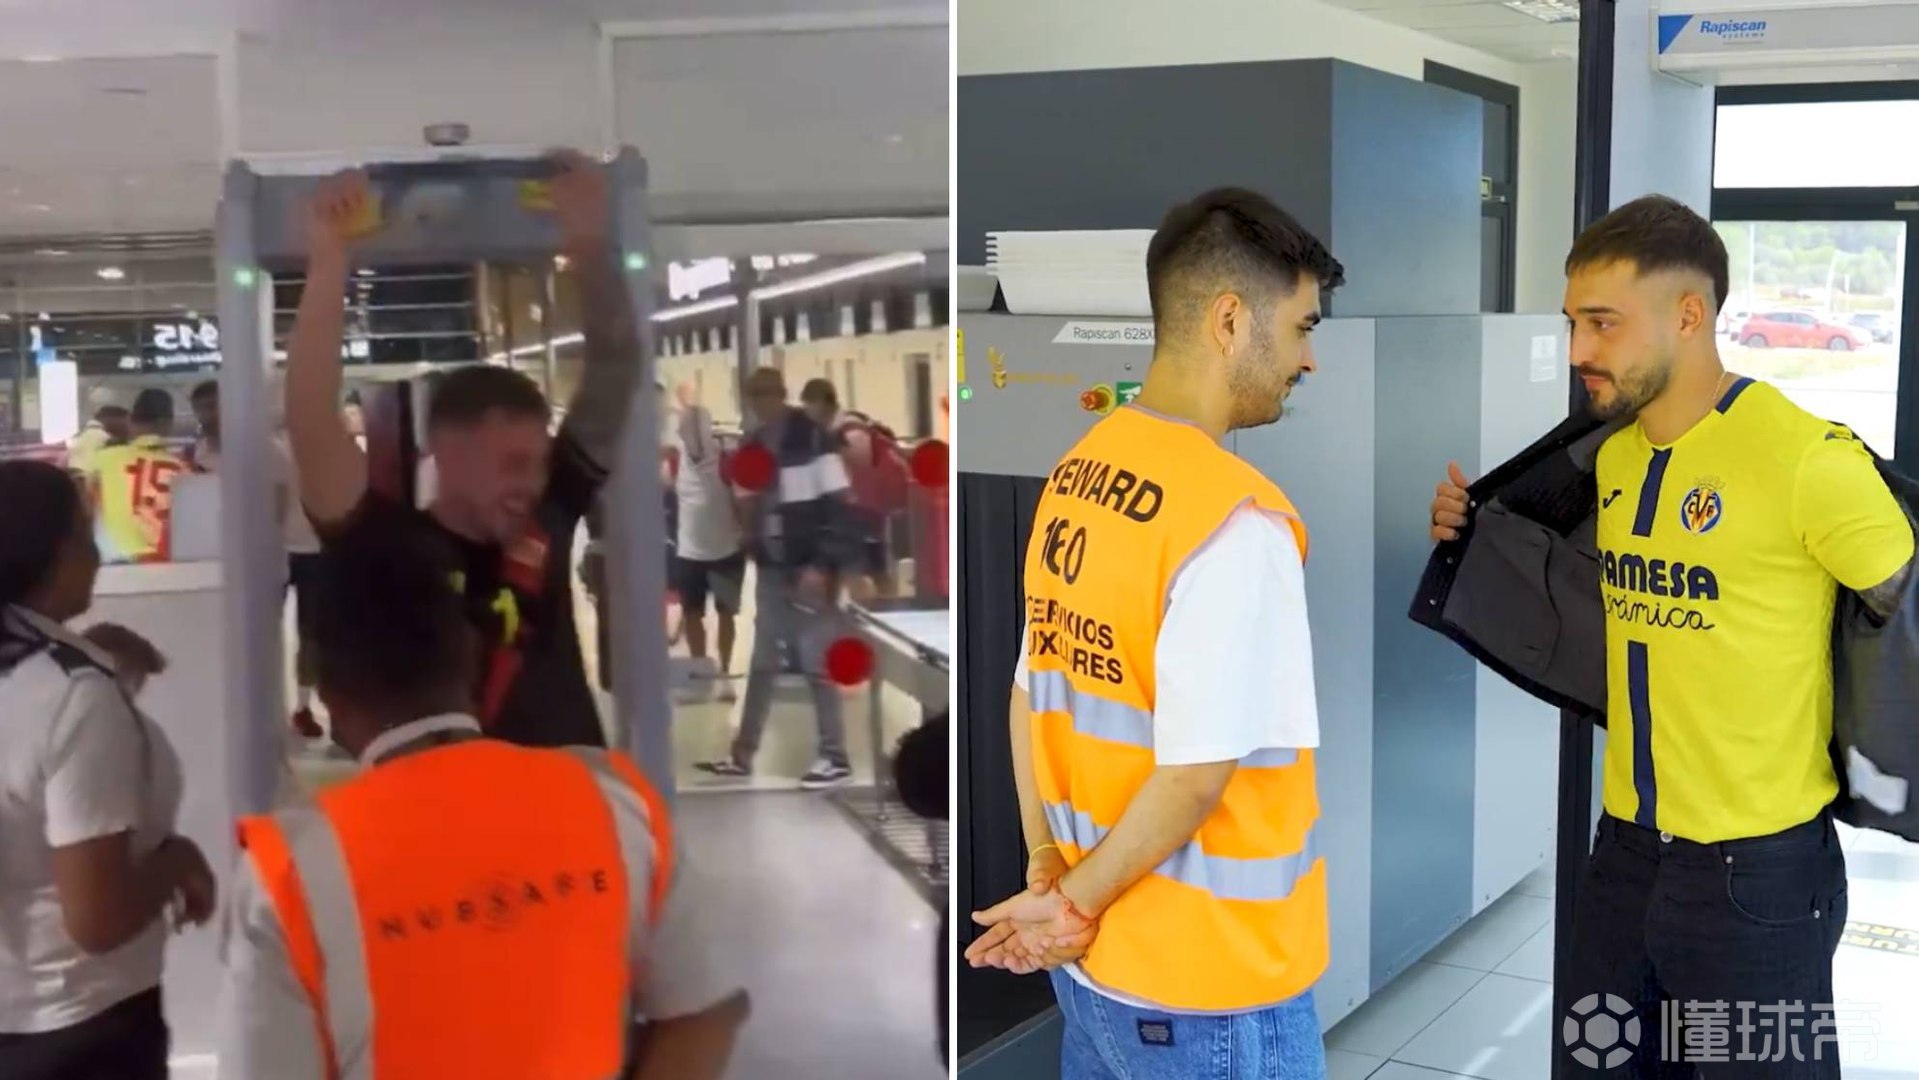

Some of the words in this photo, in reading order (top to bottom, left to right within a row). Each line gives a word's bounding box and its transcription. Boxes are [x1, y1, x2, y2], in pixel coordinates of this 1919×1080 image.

[1700, 19, 1767, 35] Rapiscan
[1073, 327, 1121, 340] Rapiscan
[1050, 458, 1164, 523] EWARD
